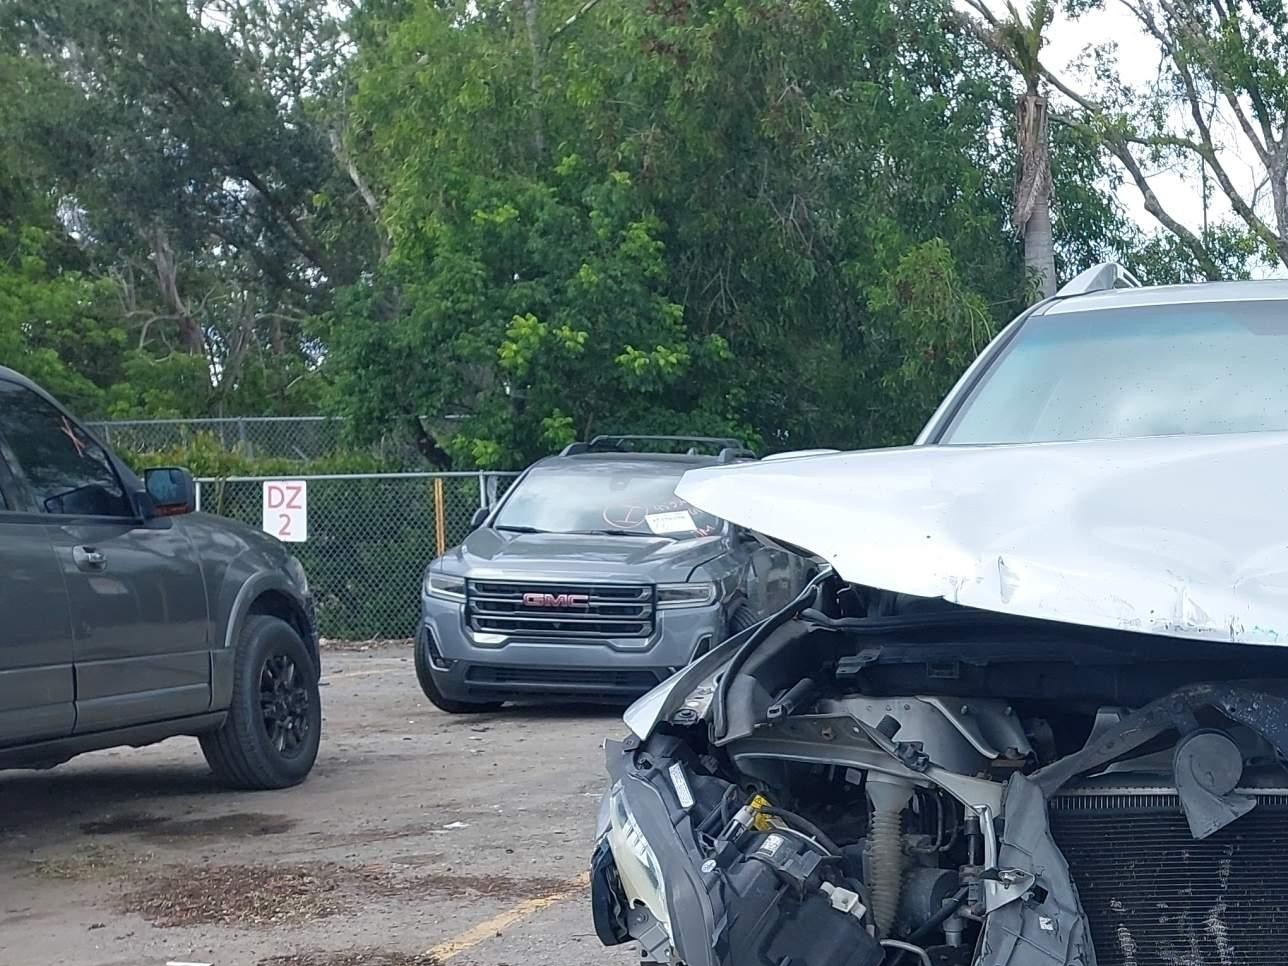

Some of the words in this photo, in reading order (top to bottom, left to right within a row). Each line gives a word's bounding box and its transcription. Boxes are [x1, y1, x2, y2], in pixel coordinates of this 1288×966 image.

[267, 485, 303, 510] DZ
[278, 513, 292, 536] 2
[522, 592, 590, 608] GMC
